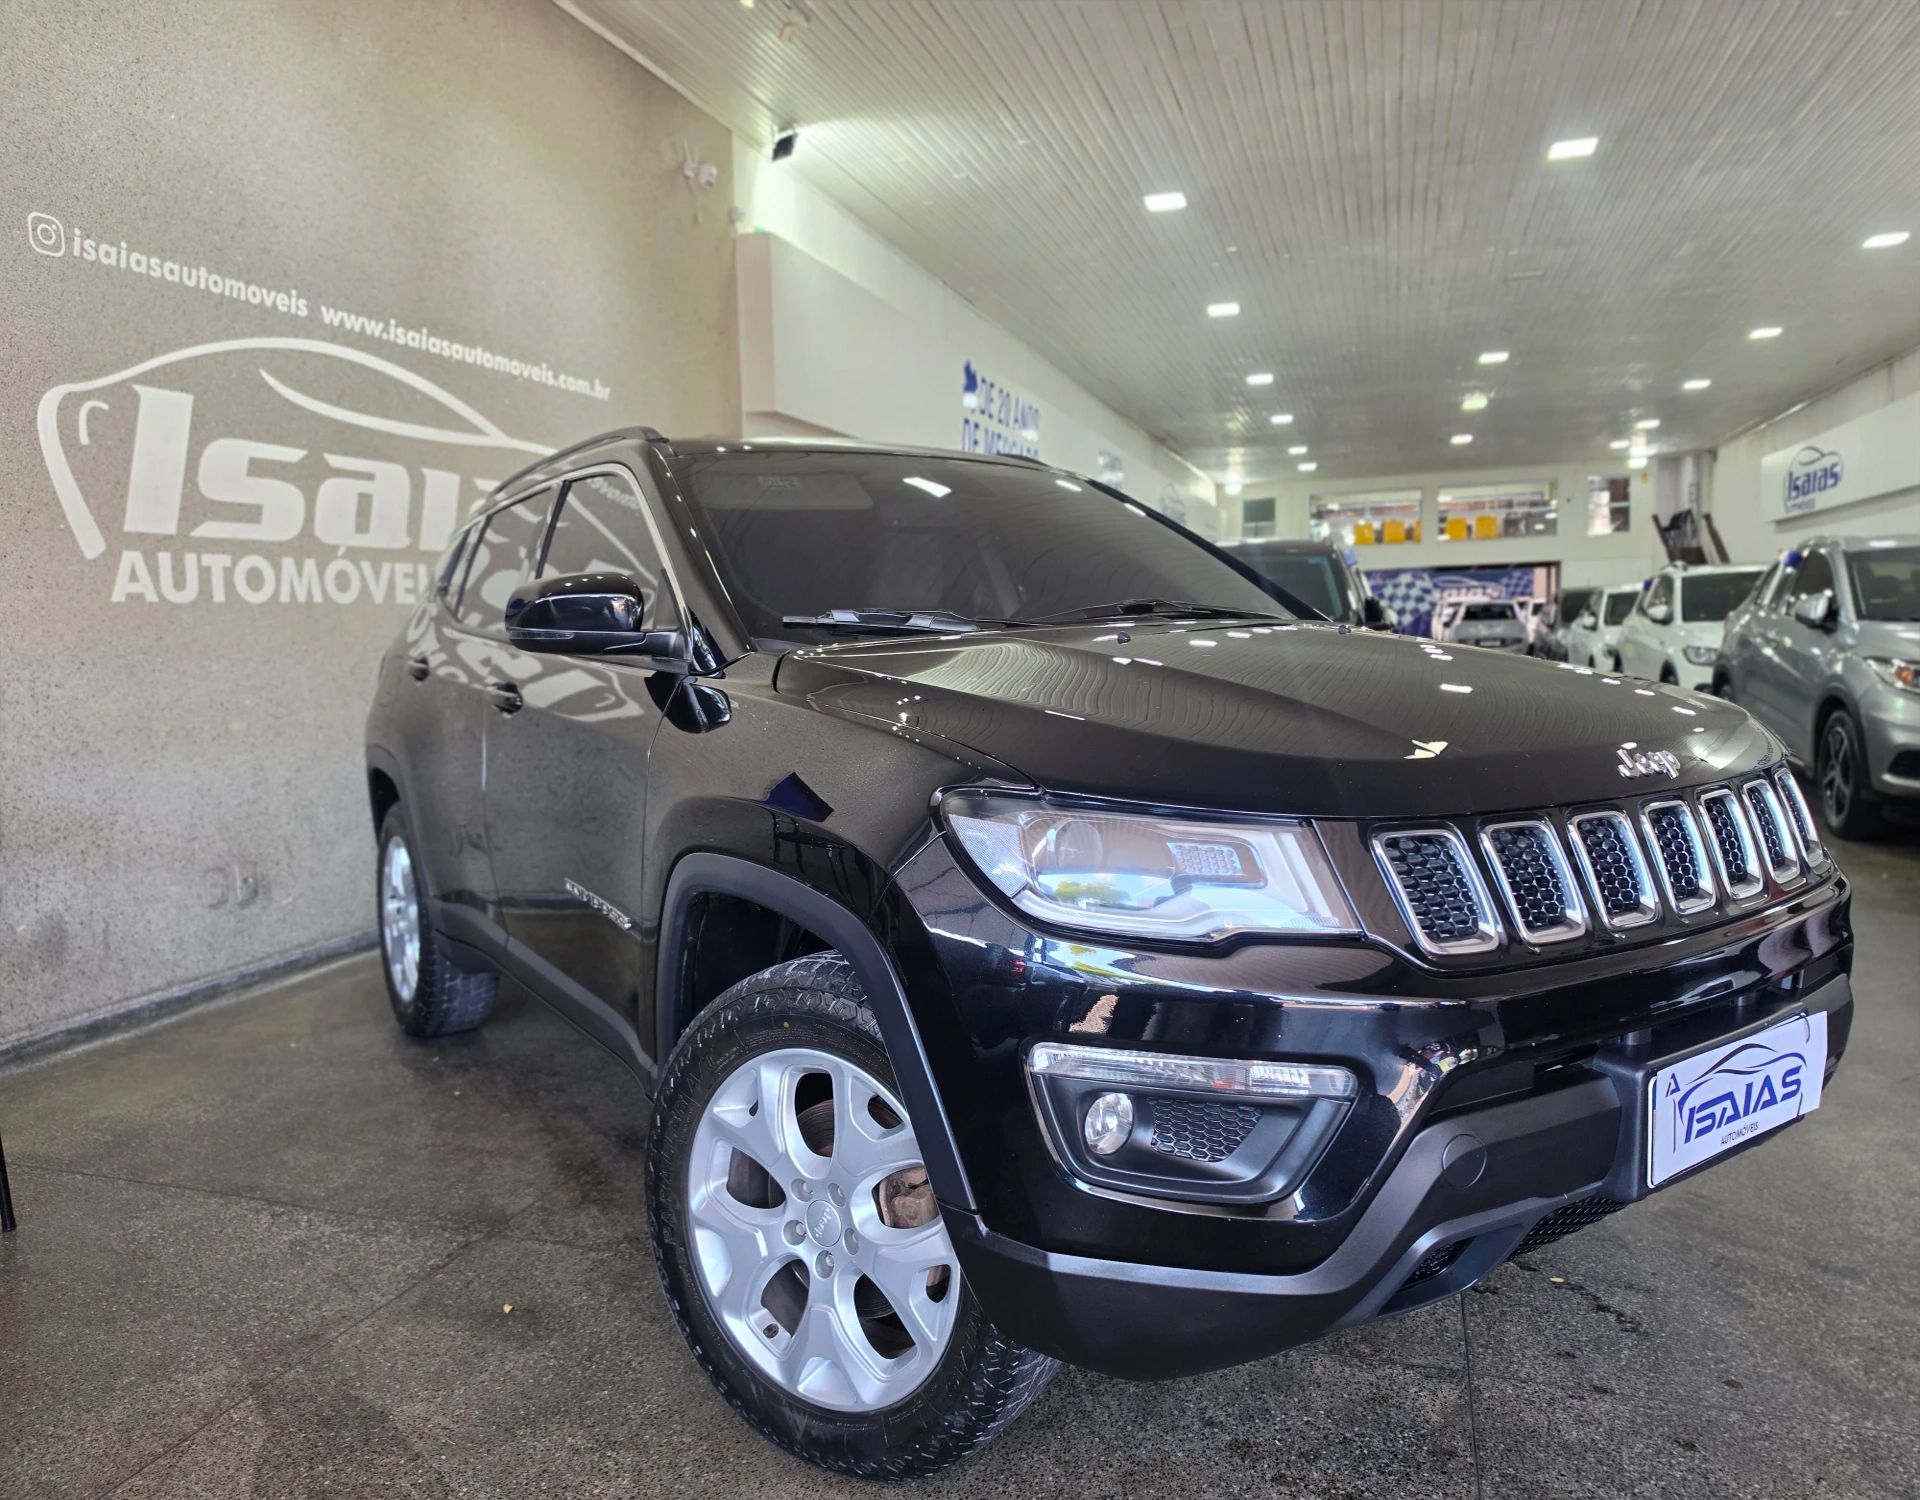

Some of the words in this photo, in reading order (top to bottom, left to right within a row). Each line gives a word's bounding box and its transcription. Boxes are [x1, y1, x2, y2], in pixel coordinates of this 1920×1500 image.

[73, 228, 309, 317] isaiasautomoveis
[321, 304, 611, 400] www.isaiasautomoveis.com.br
[124, 384, 502, 551] Isai
[1787, 462, 1840, 501] Isaias
[111, 547, 428, 604] AUTOMÓVEI
[1616, 748, 1681, 780] Jeep
[1684, 1065, 1802, 1144] ISAIAS
[1720, 1122, 1758, 1146] AUTOMÓVEIS
